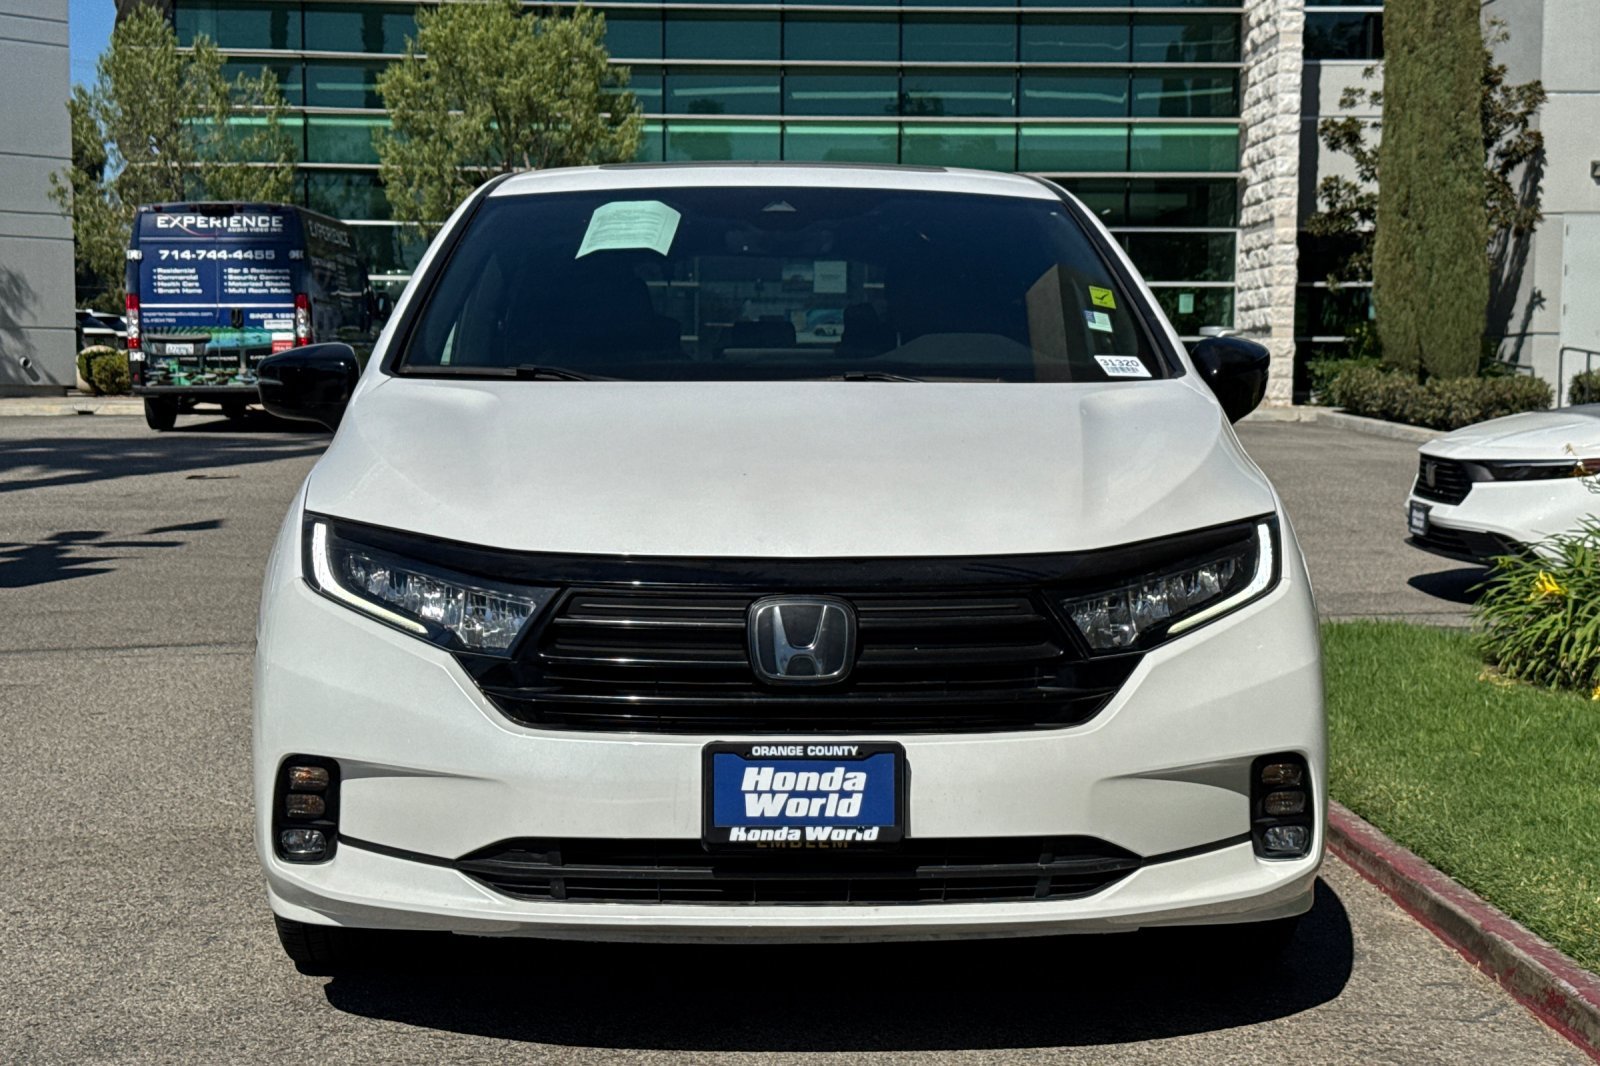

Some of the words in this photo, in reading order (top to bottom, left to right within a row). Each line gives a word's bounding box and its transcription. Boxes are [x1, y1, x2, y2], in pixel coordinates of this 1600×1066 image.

[157, 215, 283, 228] EXPERIENCE
[1099, 358, 1140, 367] 31320
[751, 745, 804, 756] ORANGE
[807, 745, 859, 756] COUNTY
[741, 766, 867, 791] Honda
[744, 792, 863, 817] World
[729, 826, 801, 841] Honda
[805, 826, 880, 841] World
